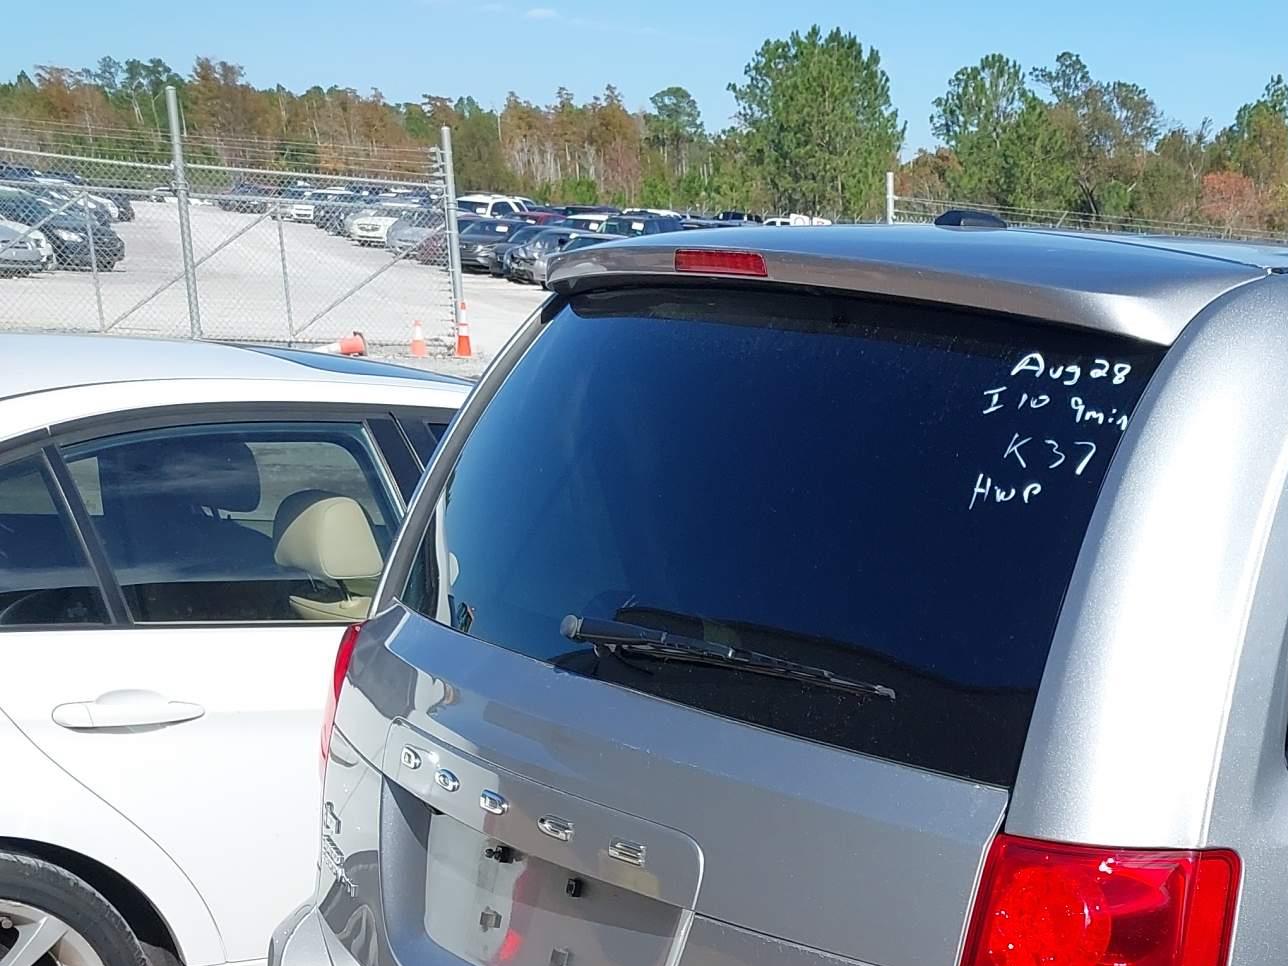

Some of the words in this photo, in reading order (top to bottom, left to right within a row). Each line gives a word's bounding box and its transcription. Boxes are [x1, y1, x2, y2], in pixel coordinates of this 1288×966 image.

[1011, 353, 1081, 385] Aug
[1090, 359, 1131, 384] 28
[400, 744, 647, 867] DODGE
